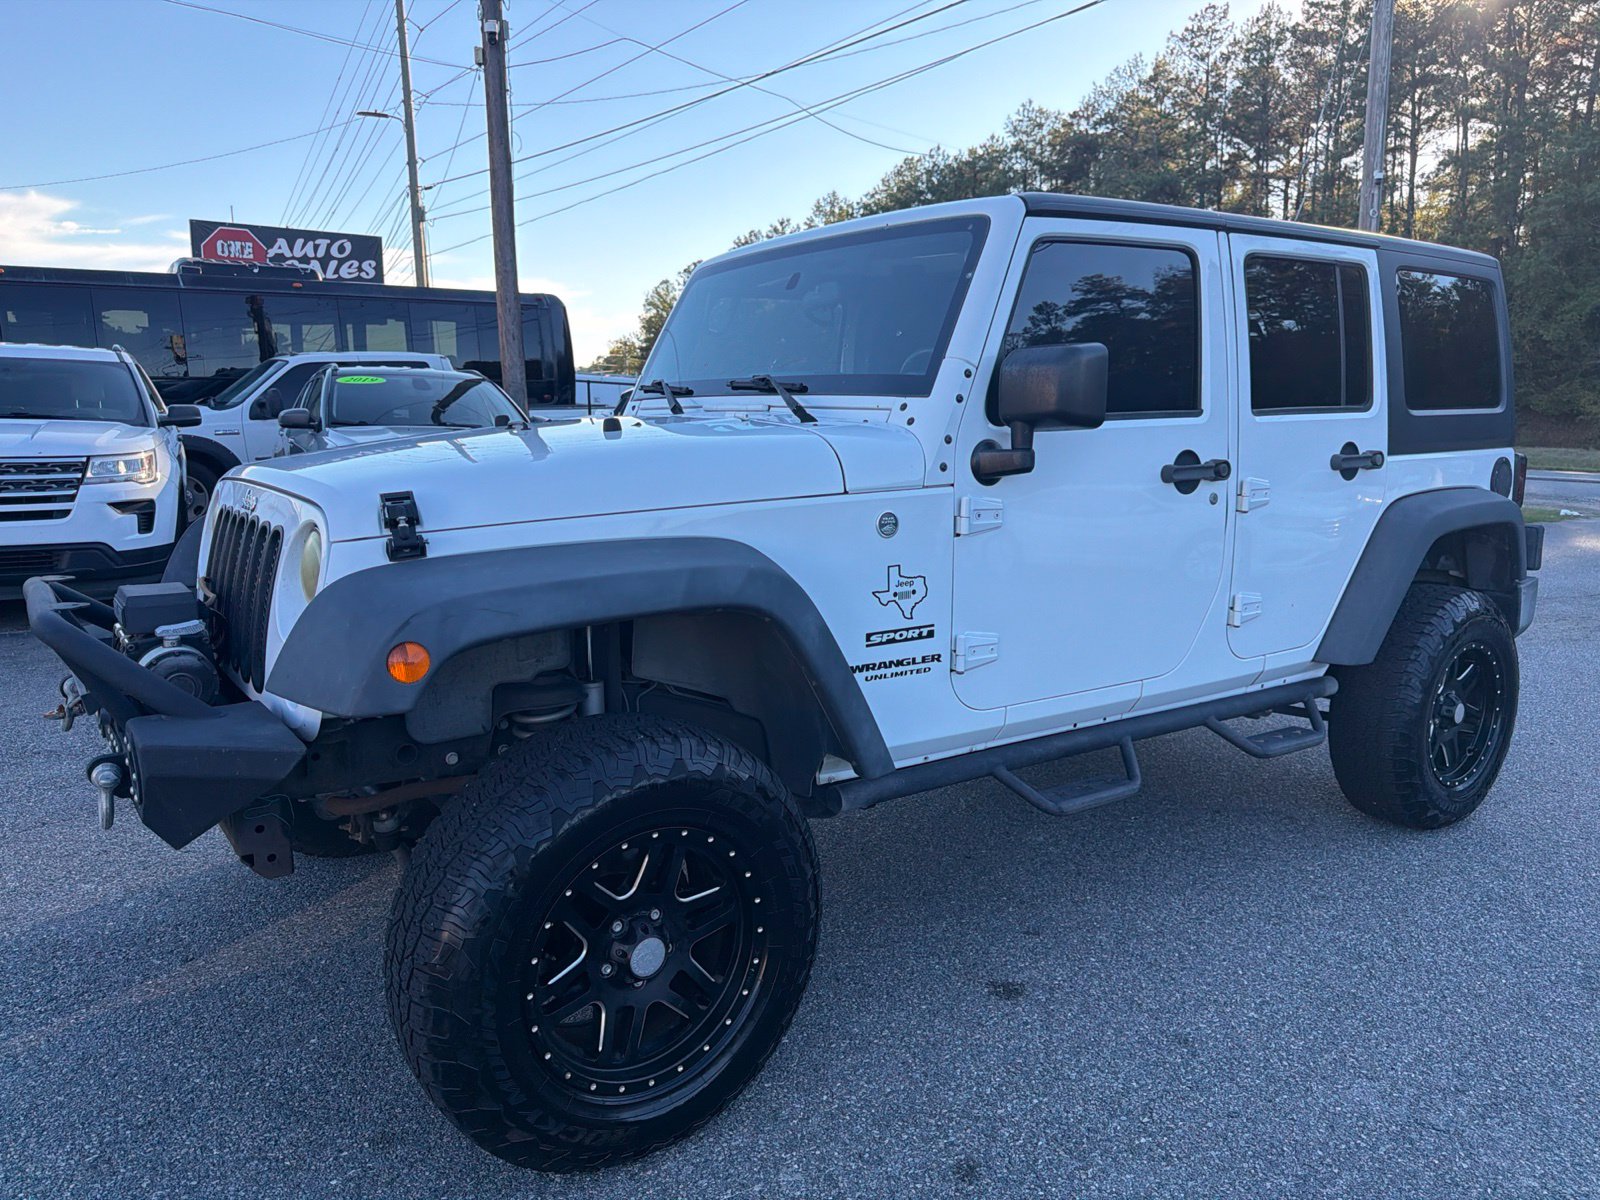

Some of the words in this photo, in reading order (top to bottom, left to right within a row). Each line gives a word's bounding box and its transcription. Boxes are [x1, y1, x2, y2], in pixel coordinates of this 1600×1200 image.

[266, 238, 352, 259] AUTO
[895, 579, 915, 588] Jeep
[866, 627, 935, 644] SPORT
[849, 653, 942, 674] WRANGLER
[864, 666, 932, 682] UNLIMITED
